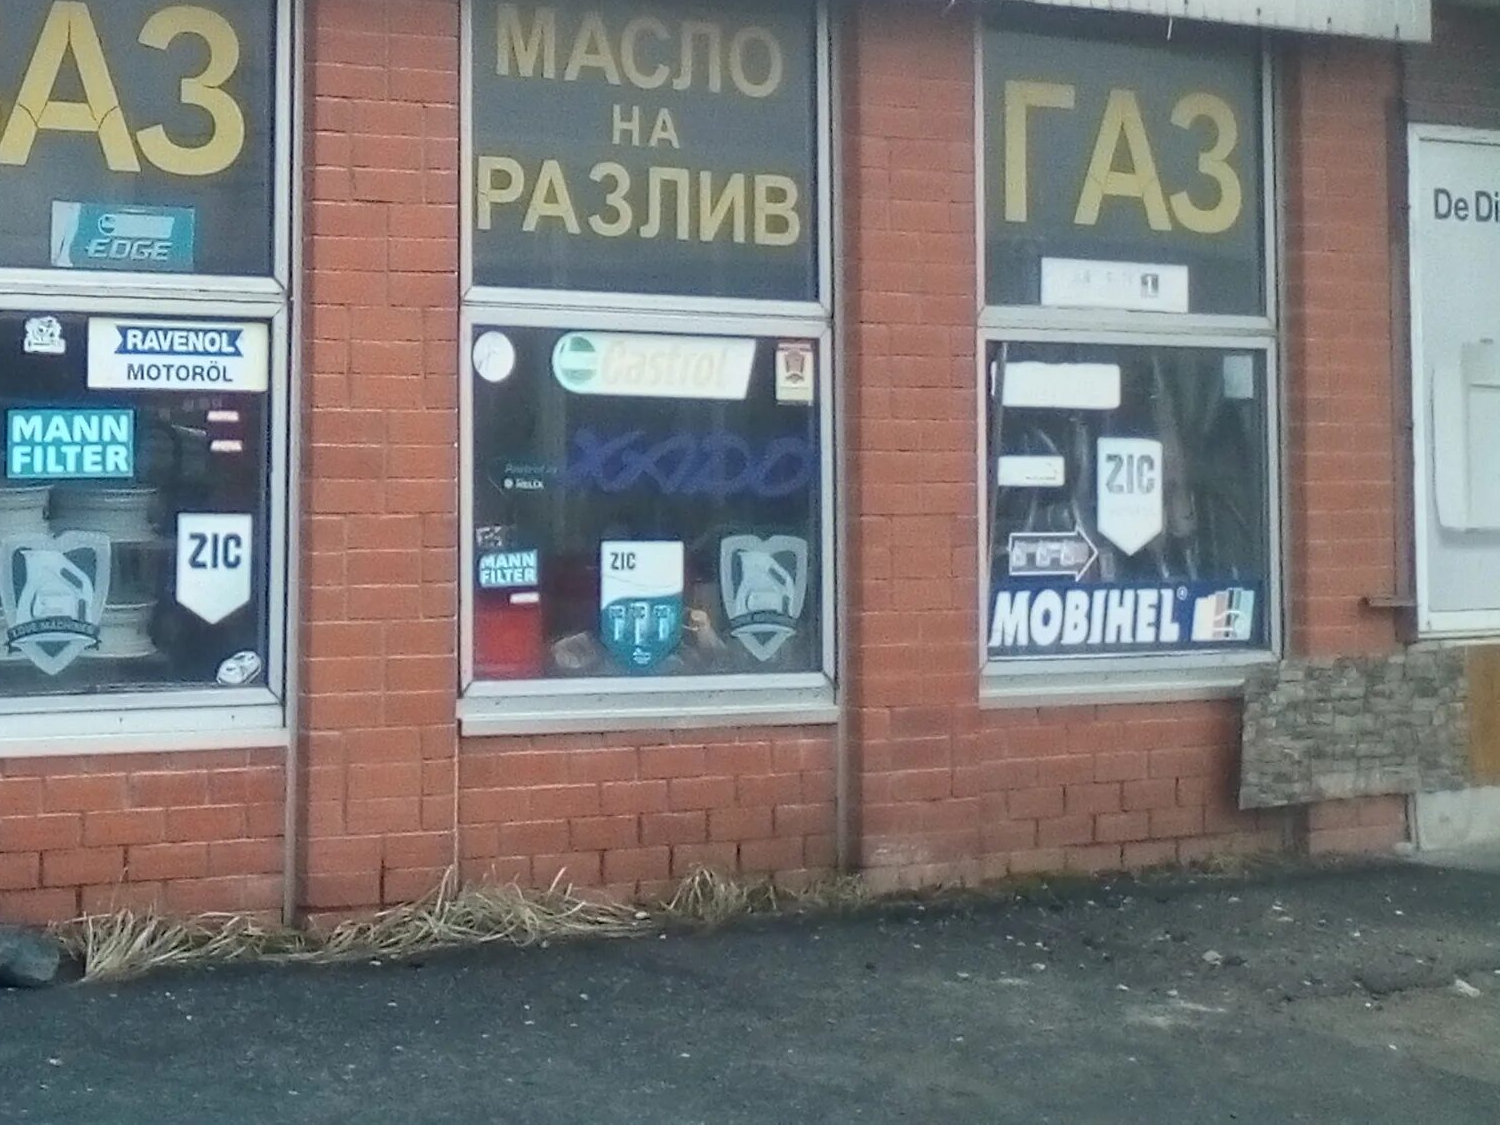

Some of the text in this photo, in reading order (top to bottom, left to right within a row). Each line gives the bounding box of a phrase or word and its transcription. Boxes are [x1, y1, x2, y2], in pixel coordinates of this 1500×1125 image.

[496, 3, 783, 98] МАСЛО
[611, 104, 680, 149] НА
[1005, 80, 1242, 233] ГАЗ
[476, 155, 801, 247] РАЗЛИВ
[1433, 187, 1469, 222] De
[86, 238, 173, 261] EDGE
[126, 328, 236, 353] RAVENOL
[126, 361, 234, 383] MOTORÖL
[601, 340, 727, 390] Castrol
[11, 415, 129, 443] MANN
[11, 445, 129, 474] FILTER
[1105, 454, 1156, 495] ZIC
[188, 533, 243, 569] ZIC
[481, 552, 535, 569] MANN
[610, 552, 636, 570] ZIC
[481, 567, 535, 584] FILTER
[988, 588, 1179, 647] MOBIHEL
